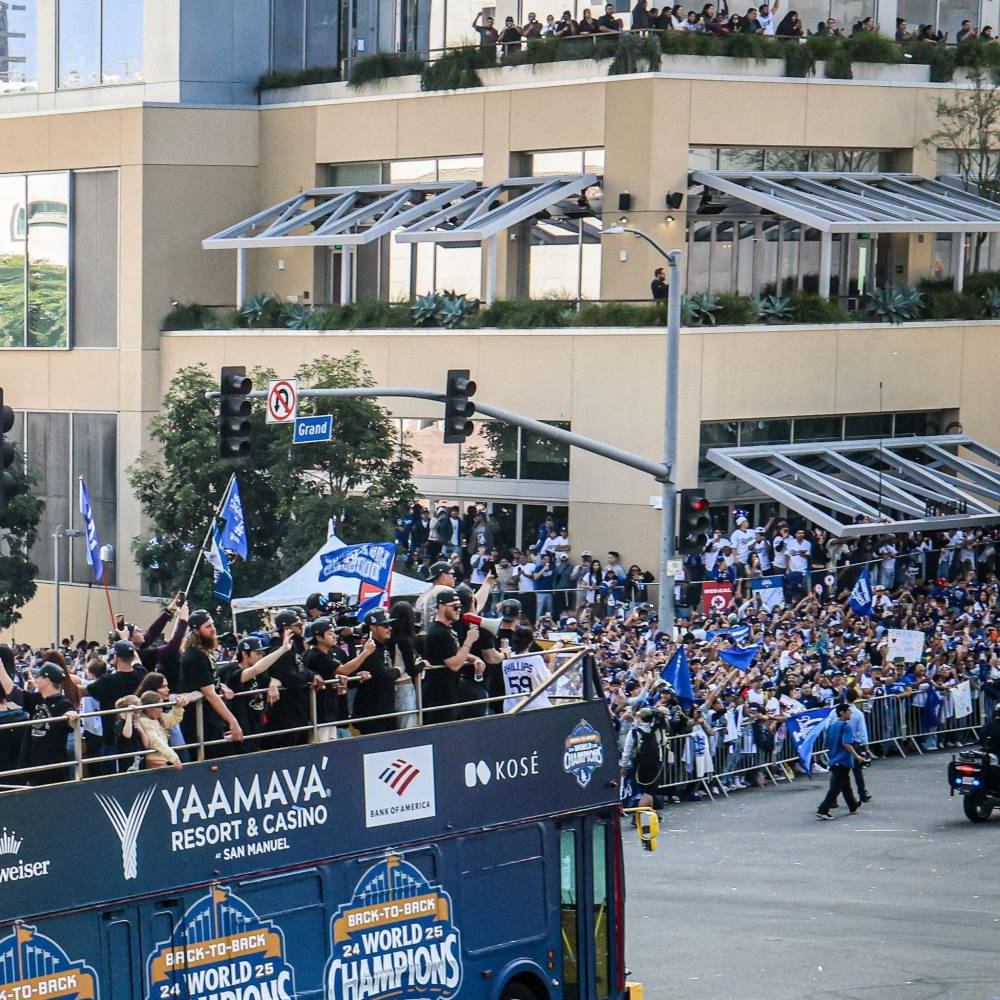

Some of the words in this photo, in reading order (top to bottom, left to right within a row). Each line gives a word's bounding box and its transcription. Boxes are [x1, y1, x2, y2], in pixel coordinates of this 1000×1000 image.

[298, 421, 328, 436] Grand
[508, 675, 534, 694] 59
[495, 751, 539, 780] KOSÉ
[370, 808, 389, 818] BANK
[390, 806, 400, 815] OF
[400, 801, 431, 813] AMERICA
[171, 820, 243, 852] RESORT
[246, 817, 259, 838] &
[262, 804, 329, 835] CASINO
[223, 845, 246, 861] SAN
[247, 837, 291, 857] MANUEL
[348, 898, 436, 927] BACK-TO-BACK
[165, 933, 266, 967] BACK-TO-BACK
[342, 943, 361, 958] 24
[361, 923, 423, 955] WORLD
[424, 925, 443, 940] 25
[160, 983, 181, 999] 24
[183, 960, 252, 996] WORLD
[254, 962, 274, 978] 25
